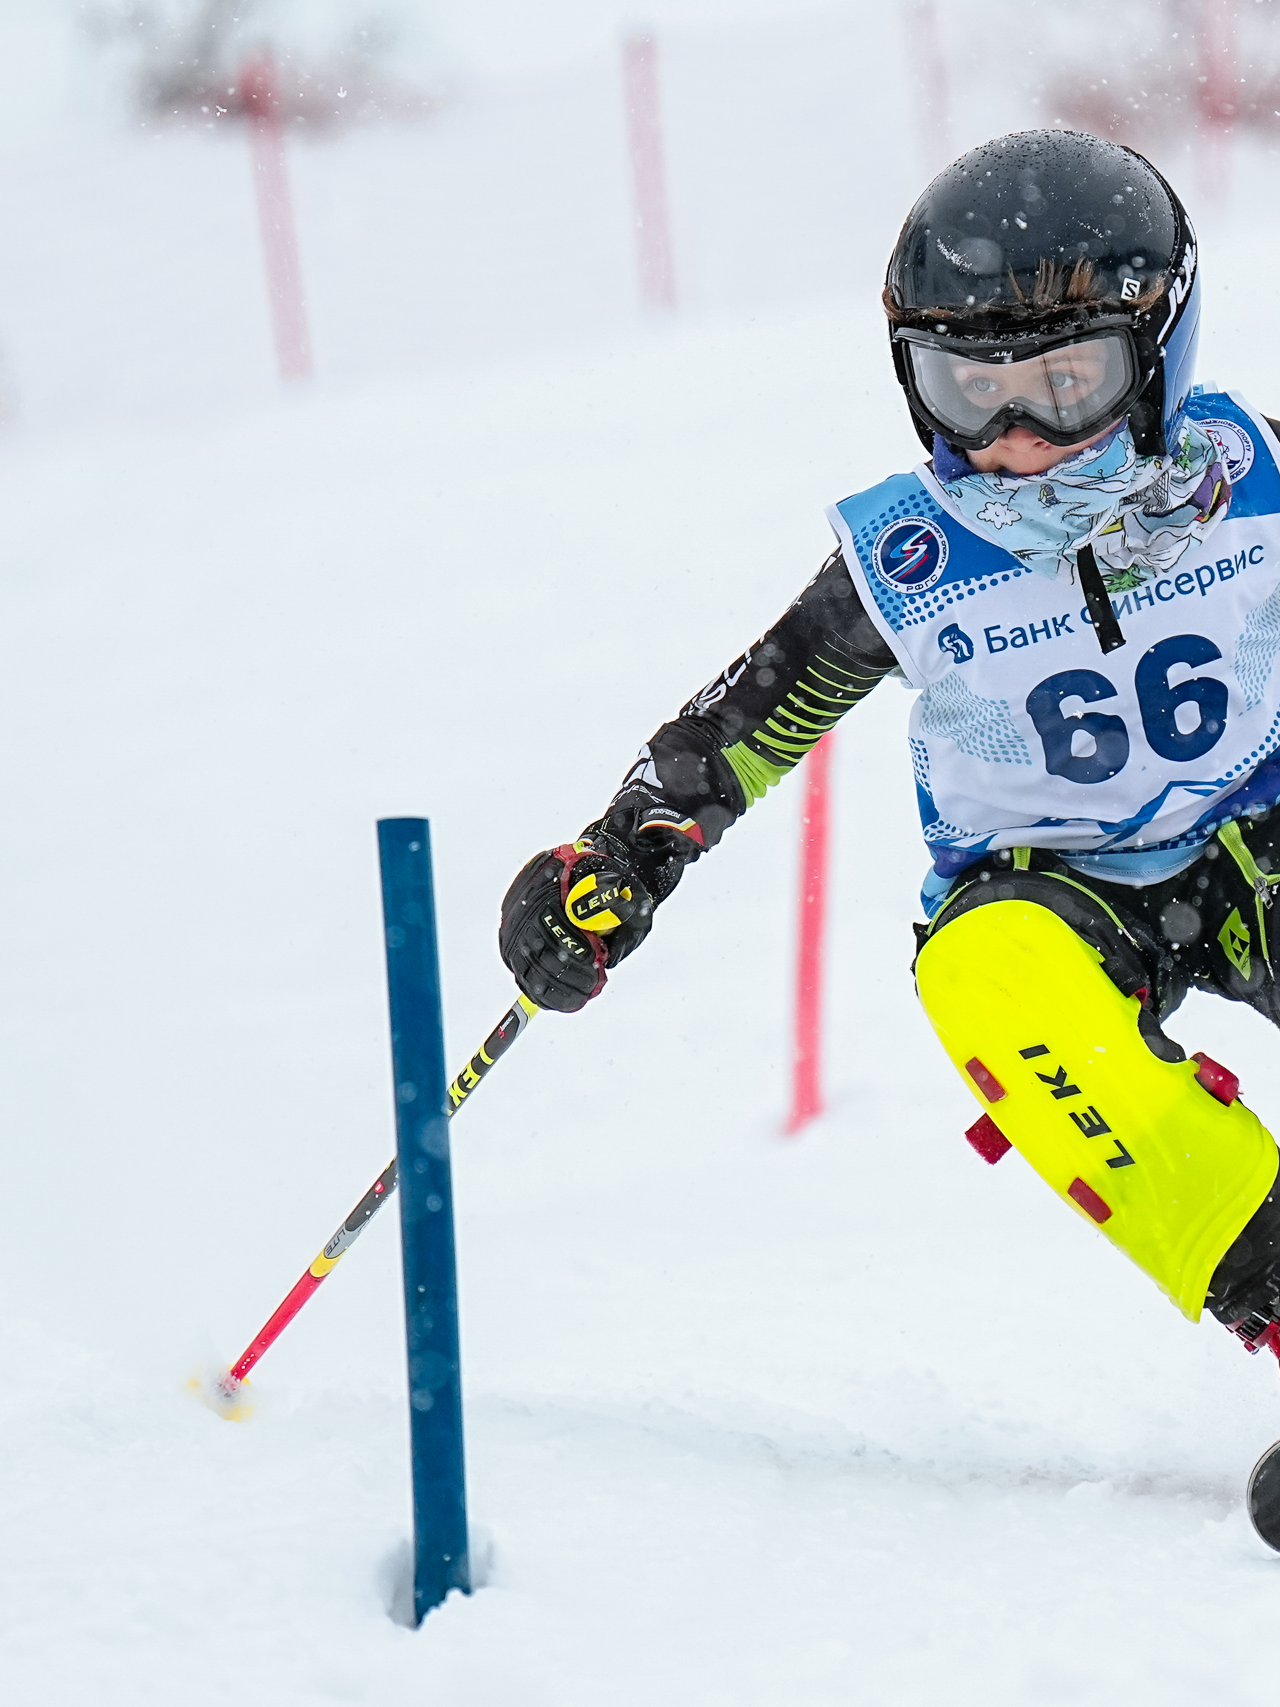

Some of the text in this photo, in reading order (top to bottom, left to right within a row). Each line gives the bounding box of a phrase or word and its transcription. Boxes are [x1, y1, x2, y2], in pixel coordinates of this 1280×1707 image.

[1236, 428, 1252, 452] СПОРТУ
[906, 574, 938, 592] РФГС
[983, 613, 1075, 654] Банк
[1025, 633, 1229, 784] 66
[576, 887, 619, 916] LEKI
[544, 915, 585, 955] LEKI
[448, 1044, 494, 1116] LEK
[1018, 1044, 1136, 1169] LEKI
[326, 1229, 346, 1256] LITE
